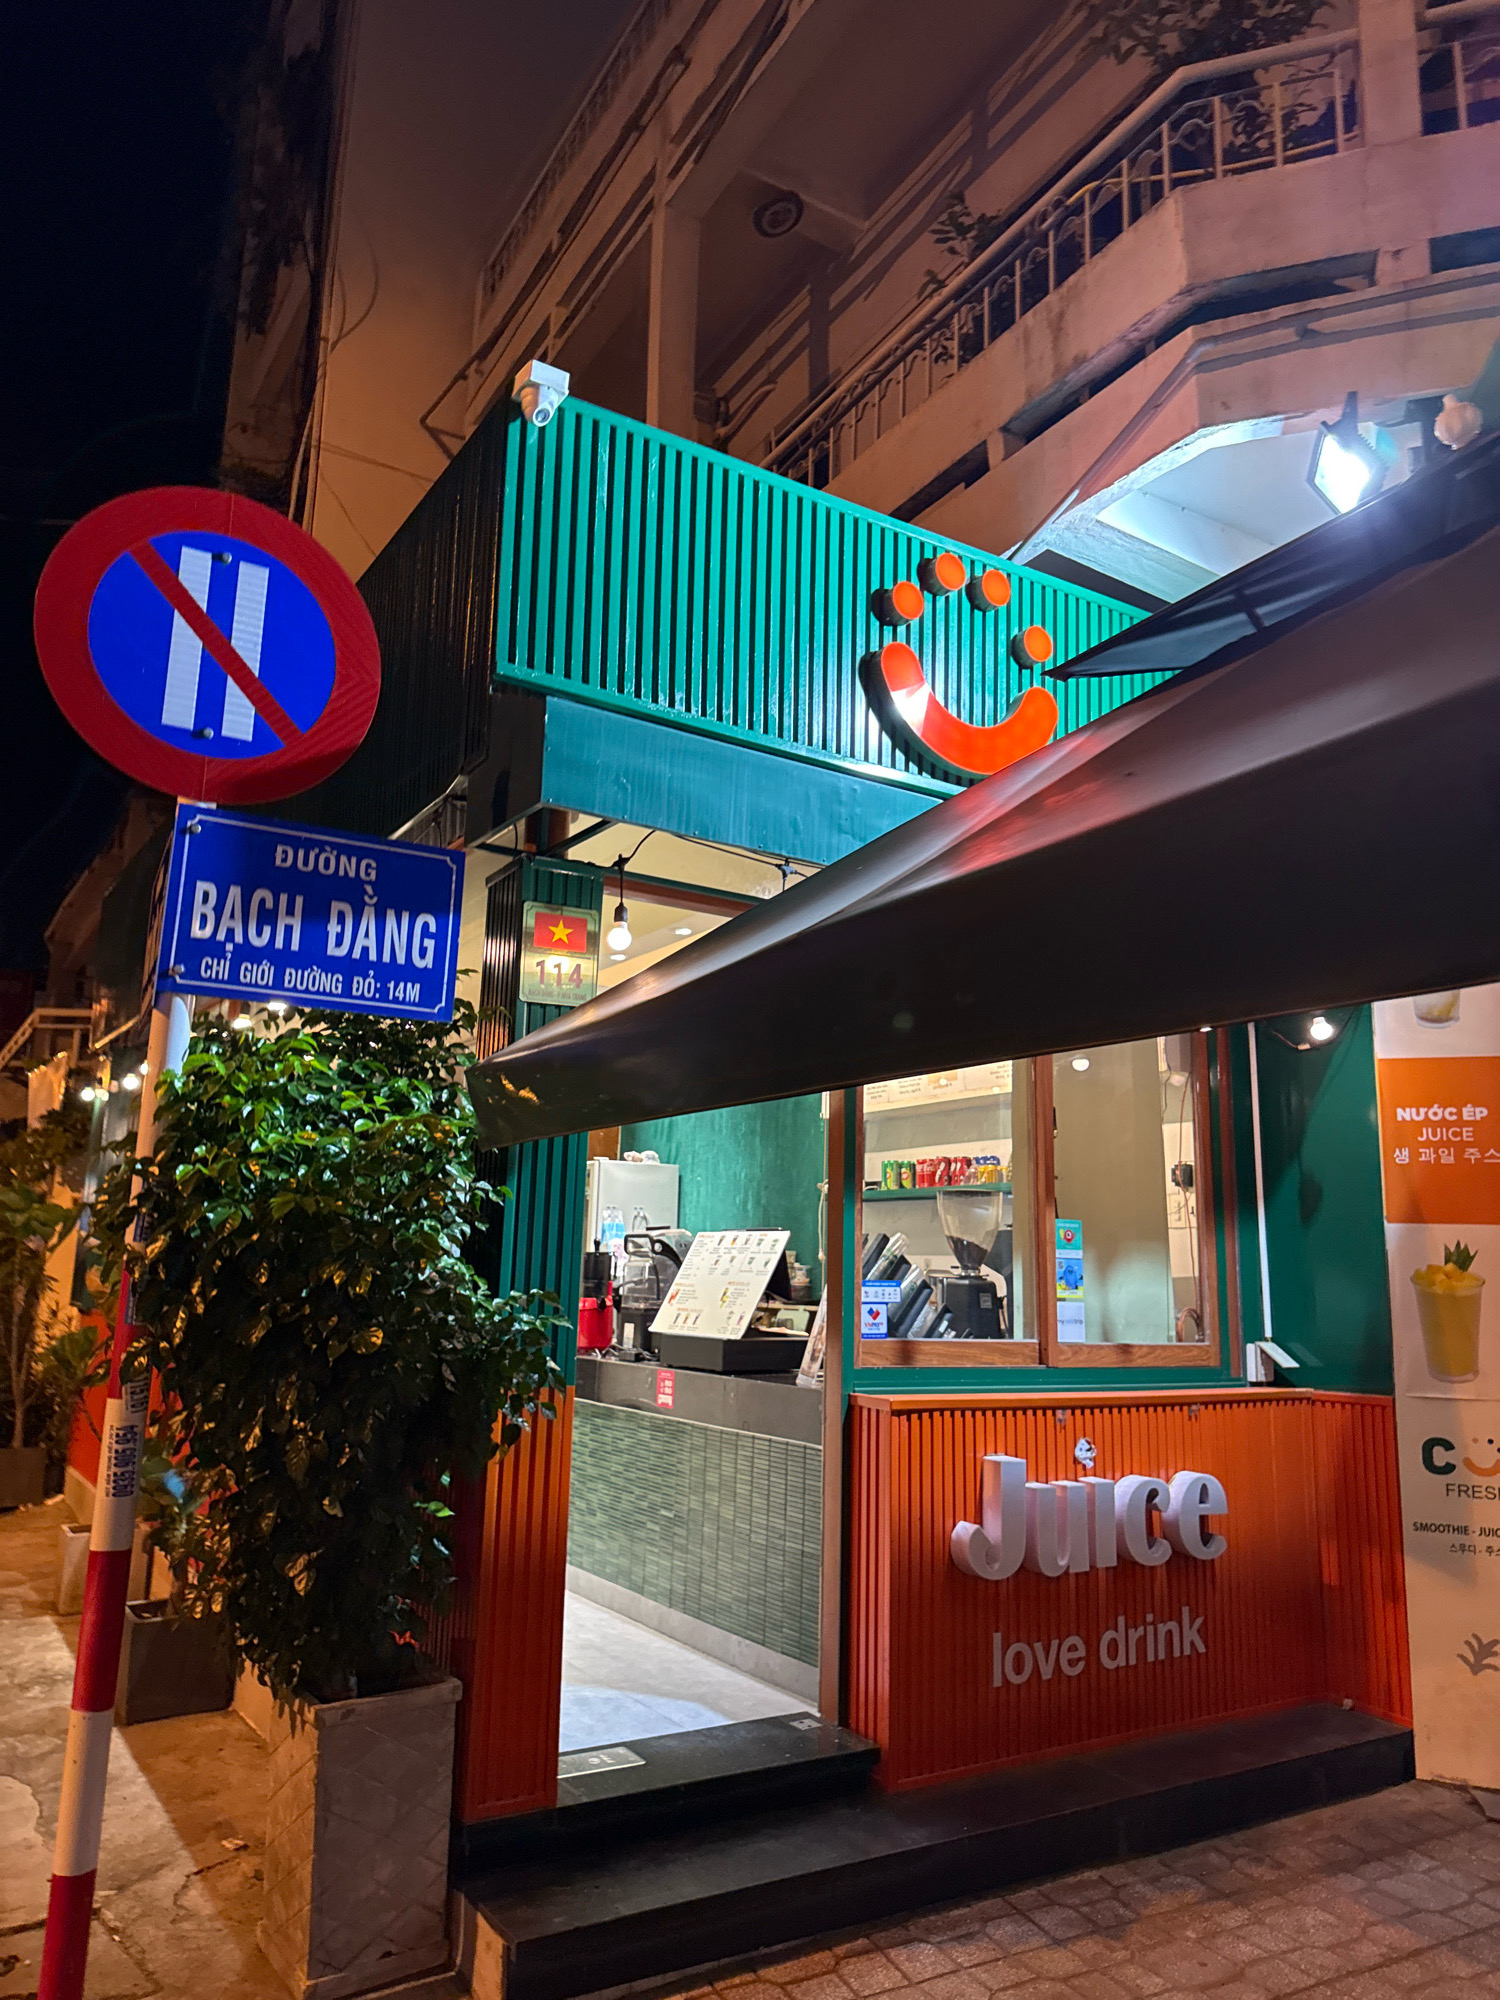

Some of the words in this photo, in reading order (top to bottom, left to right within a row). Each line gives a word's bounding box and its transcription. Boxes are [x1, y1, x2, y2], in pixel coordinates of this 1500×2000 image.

[274, 843, 378, 882] ĐƯỜNG
[190, 879, 304, 953] BẠCH
[326, 884, 437, 970] ĐẰNG
[200, 954, 231, 982] CHỈ
[239, 958, 275, 987] GIỚI
[284, 964, 343, 995] ĐƯỜNG
[352, 970, 381, 999] ĐỎ:
[387, 980, 421, 1004] 14M
[536, 959, 583, 989] 114
[1396, 1103, 1458, 1121] NƯỚC
[1462, 1103, 1488, 1121] ÉP
[1417, 1127, 1475, 1141] JUICE
[1393, 1147, 1410, 1165] 생
[1418, 1147, 1455, 1165] 과일
[1463, 1147, 1500, 1165] 주스
[951, 1454, 1228, 1580] Juice
[1412, 1522, 1469, 1536] SMOOTHIE
[993, 1630, 1086, 1688] love
[1099, 1605, 1206, 1670] drink
